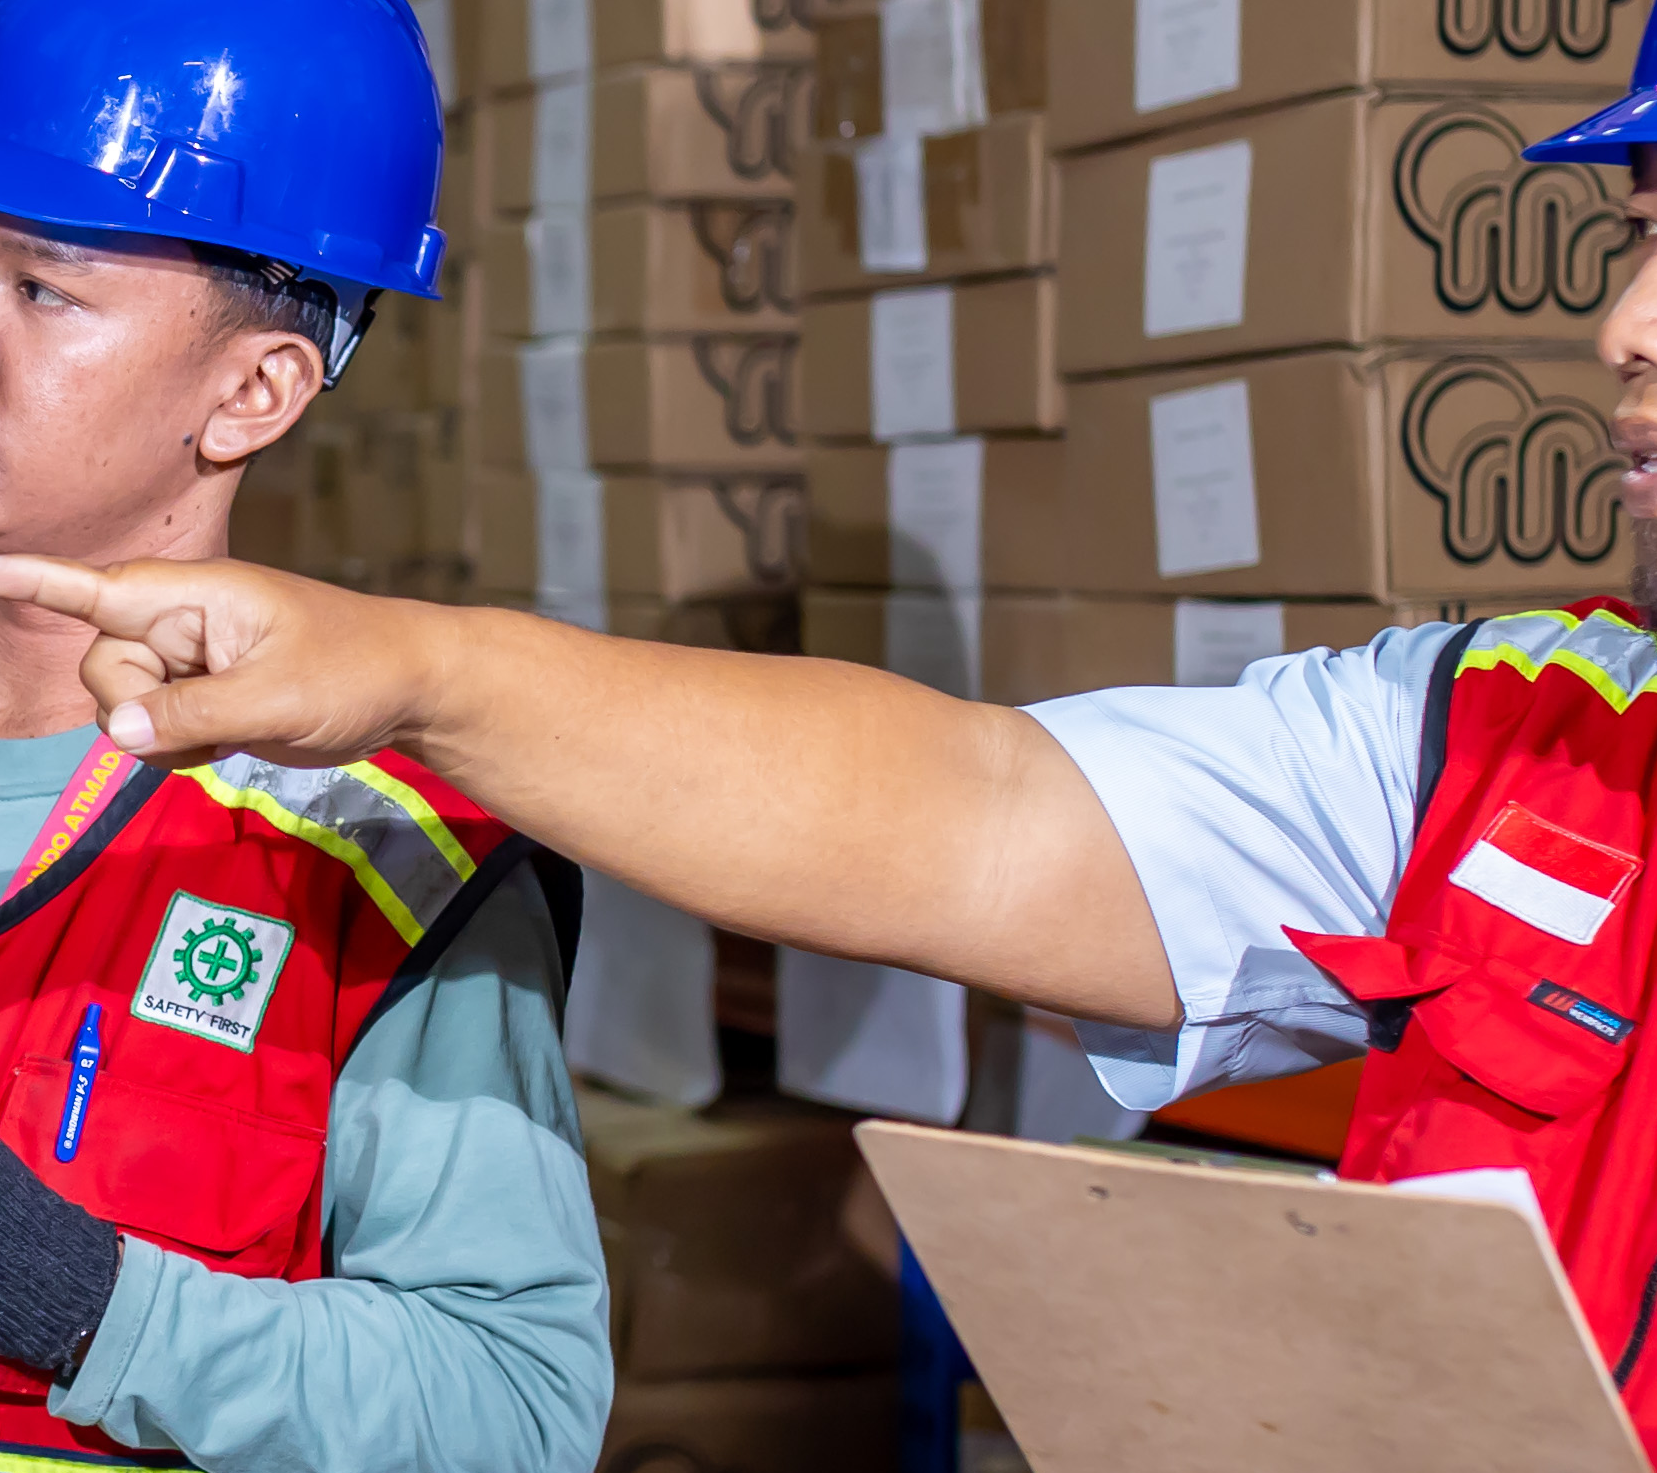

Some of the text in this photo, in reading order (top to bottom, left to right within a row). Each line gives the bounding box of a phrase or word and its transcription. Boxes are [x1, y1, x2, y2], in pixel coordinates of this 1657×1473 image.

[144, 995, 251, 1039] SAFETY FIRST
[65, 1094, 83, 1141] SNOWMAN
